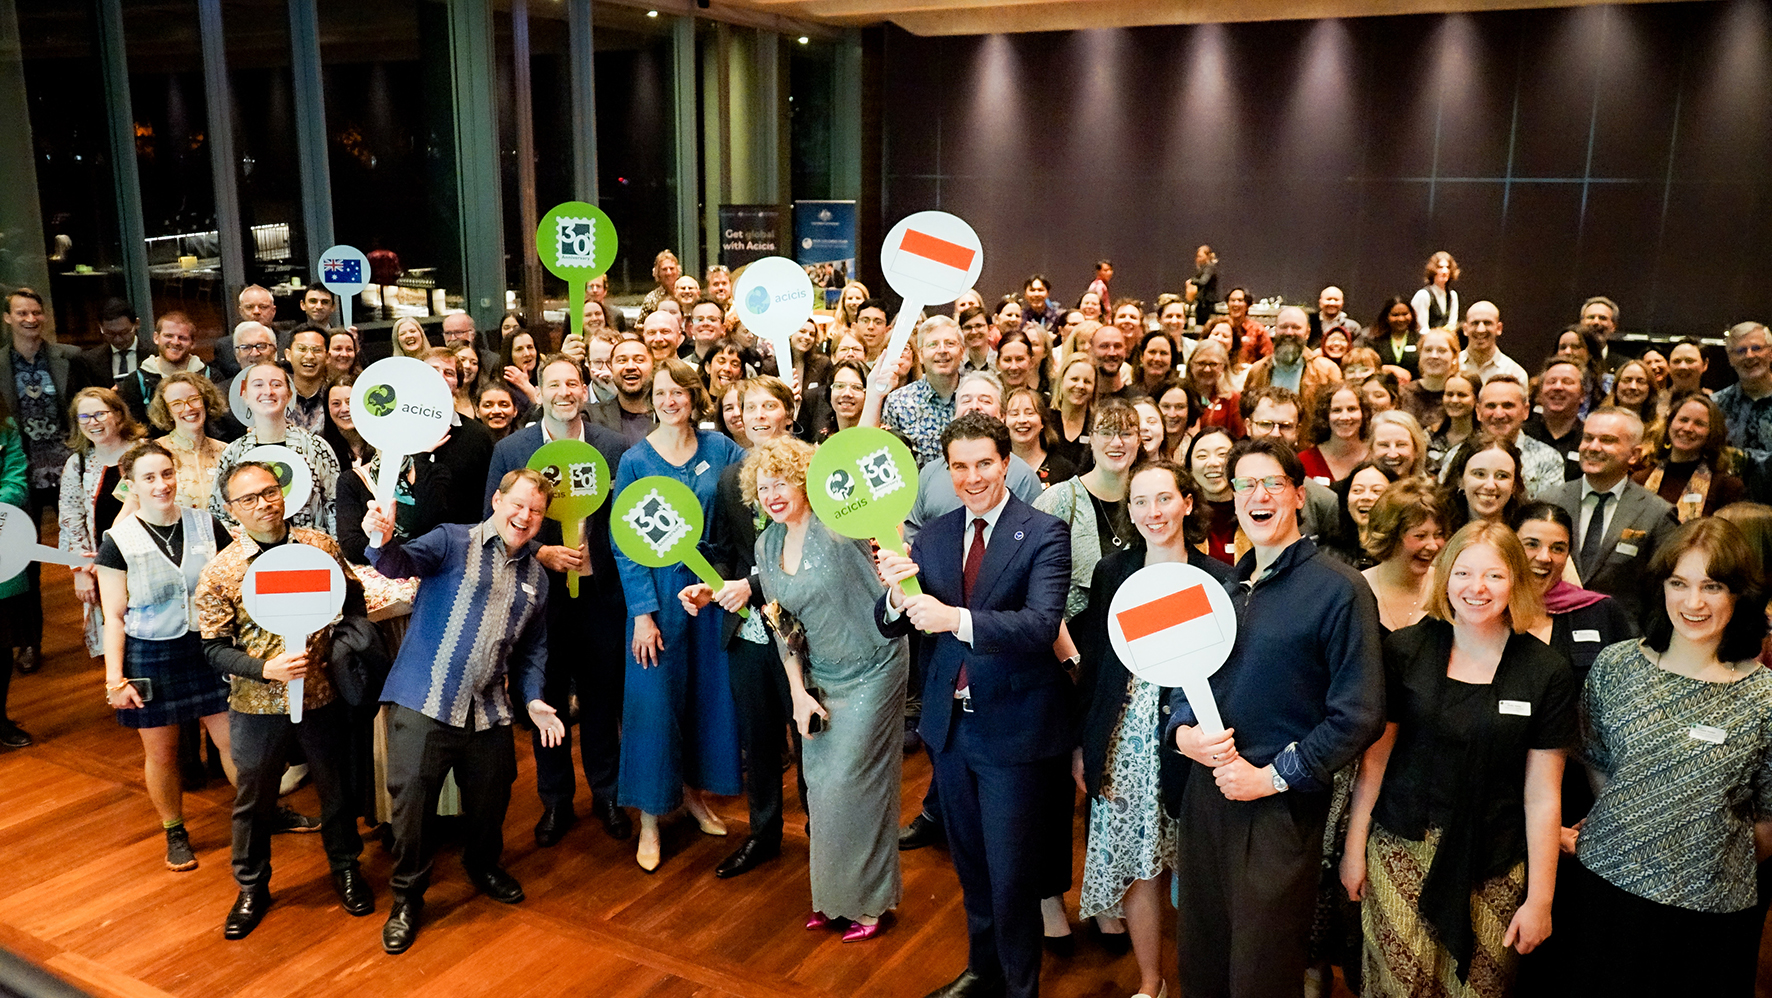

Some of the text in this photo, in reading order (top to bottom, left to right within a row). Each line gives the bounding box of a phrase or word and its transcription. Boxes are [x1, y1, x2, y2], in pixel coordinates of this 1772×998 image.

[725, 229, 775, 241] Get global
[723, 241, 745, 250] with
[775, 289, 807, 303] acicis
[401, 403, 443, 420] acicis
[834, 498, 868, 520] acicis
[657, 525, 683, 547] Anniversary
